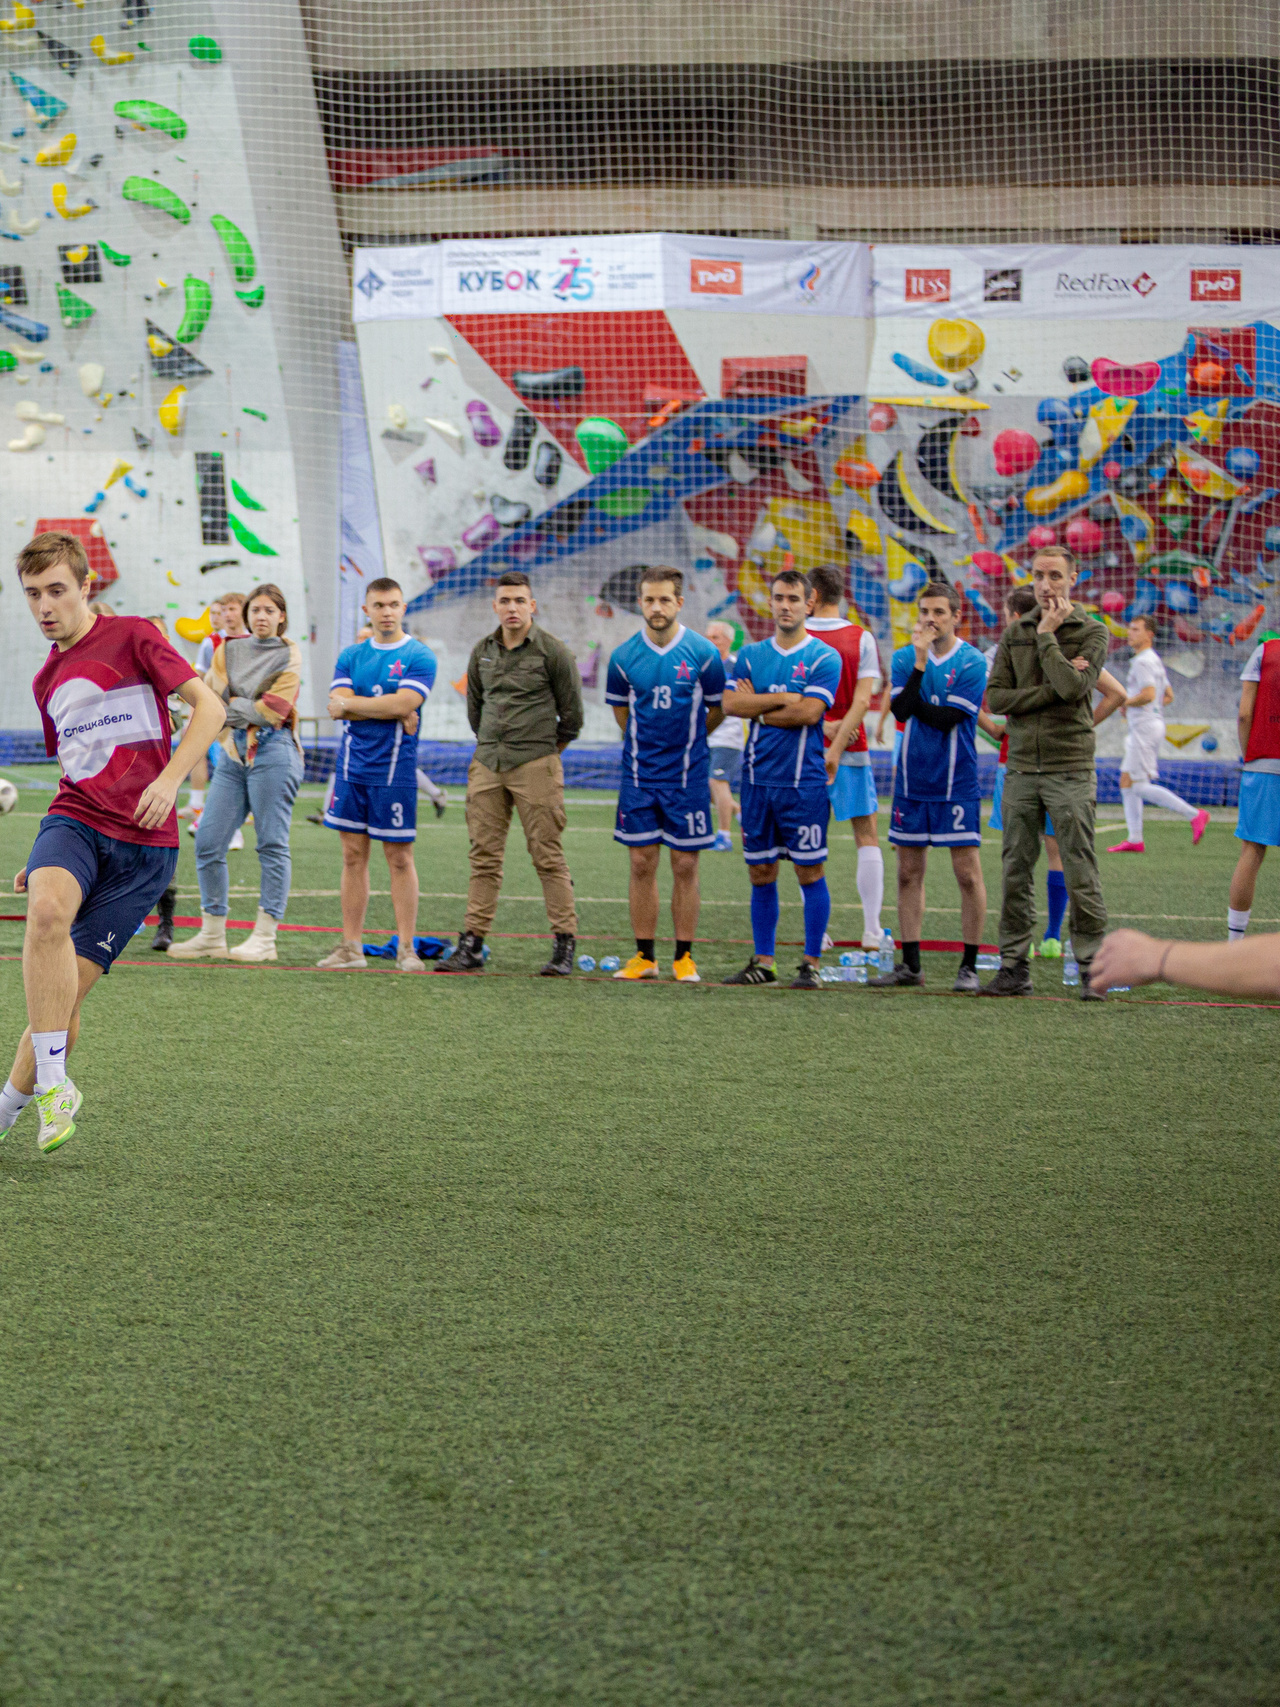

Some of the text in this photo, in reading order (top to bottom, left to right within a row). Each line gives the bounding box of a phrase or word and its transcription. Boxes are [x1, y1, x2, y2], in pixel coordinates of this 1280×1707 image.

[458, 269, 541, 292] КУБОК
[1056, 272, 1131, 292] RedFox
[651, 685, 672, 709] 13
[63, 713, 133, 738] Спецкабель
[391, 802, 404, 827] 3
[684, 810, 707, 836] 13
[951, 804, 966, 830] 2
[797, 823, 822, 850] 20
